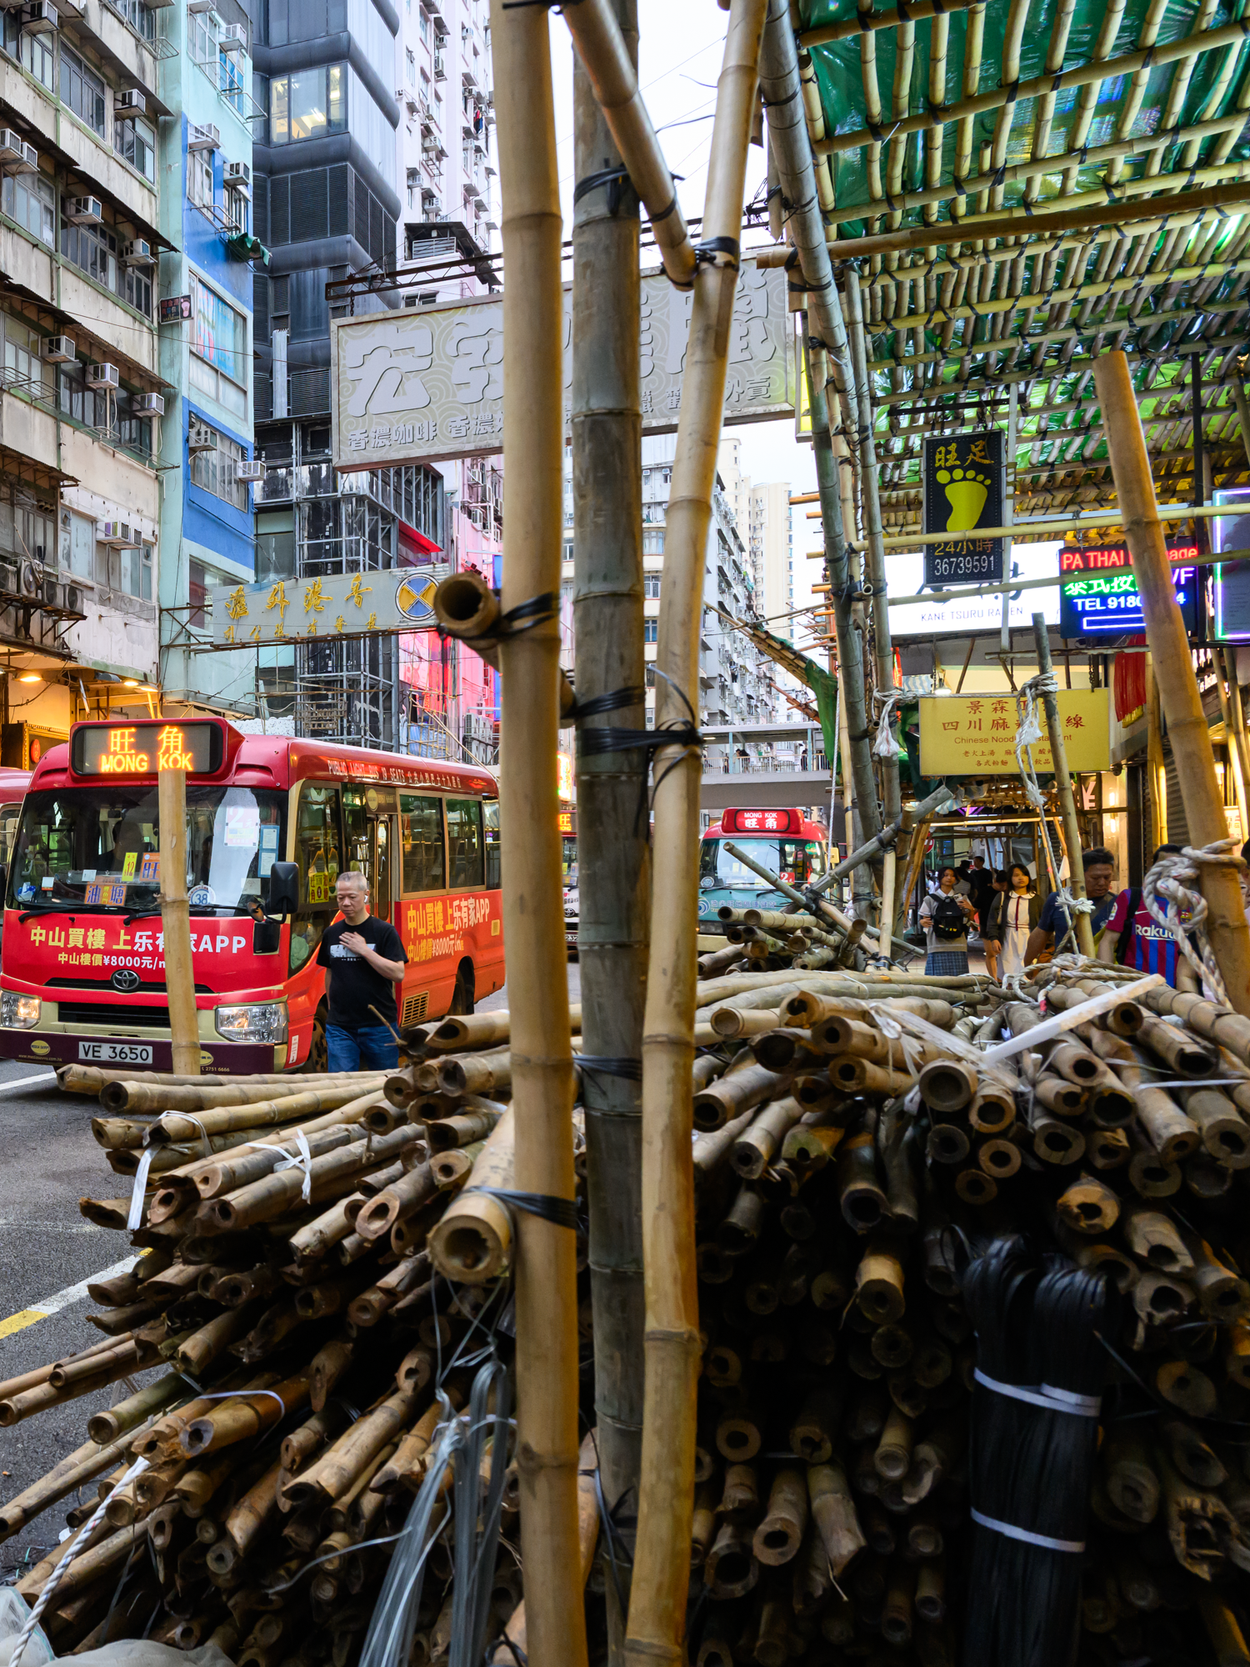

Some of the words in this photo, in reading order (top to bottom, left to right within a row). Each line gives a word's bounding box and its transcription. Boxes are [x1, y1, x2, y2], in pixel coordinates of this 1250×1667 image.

[349, 422, 438, 452] 香濃咖啡
[935, 440, 994, 468] 旺足
[934, 555, 994, 576] 36739591
[1062, 553, 1084, 570] PA
[1086, 550, 1125, 569] THAI
[921, 612, 946, 621] KANE
[951, 609, 984, 620] TSURU
[989, 607, 1023, 618] RAEN
[1073, 599, 1106, 611] TEL
[942, 714, 1085, 731] 四川麻線
[110, 725, 184, 754] 旺角
[954, 736, 988, 744] Chinese
[100, 754, 148, 772] MONG
[158, 753, 193, 771] KOK
[745, 818, 777, 829] 旺角
[407, 900, 444, 938] 中山買樓
[30, 926, 106, 950] 中山買樓
[83, 1043, 101, 1058] VE
[108, 1045, 149, 1061] 3650
